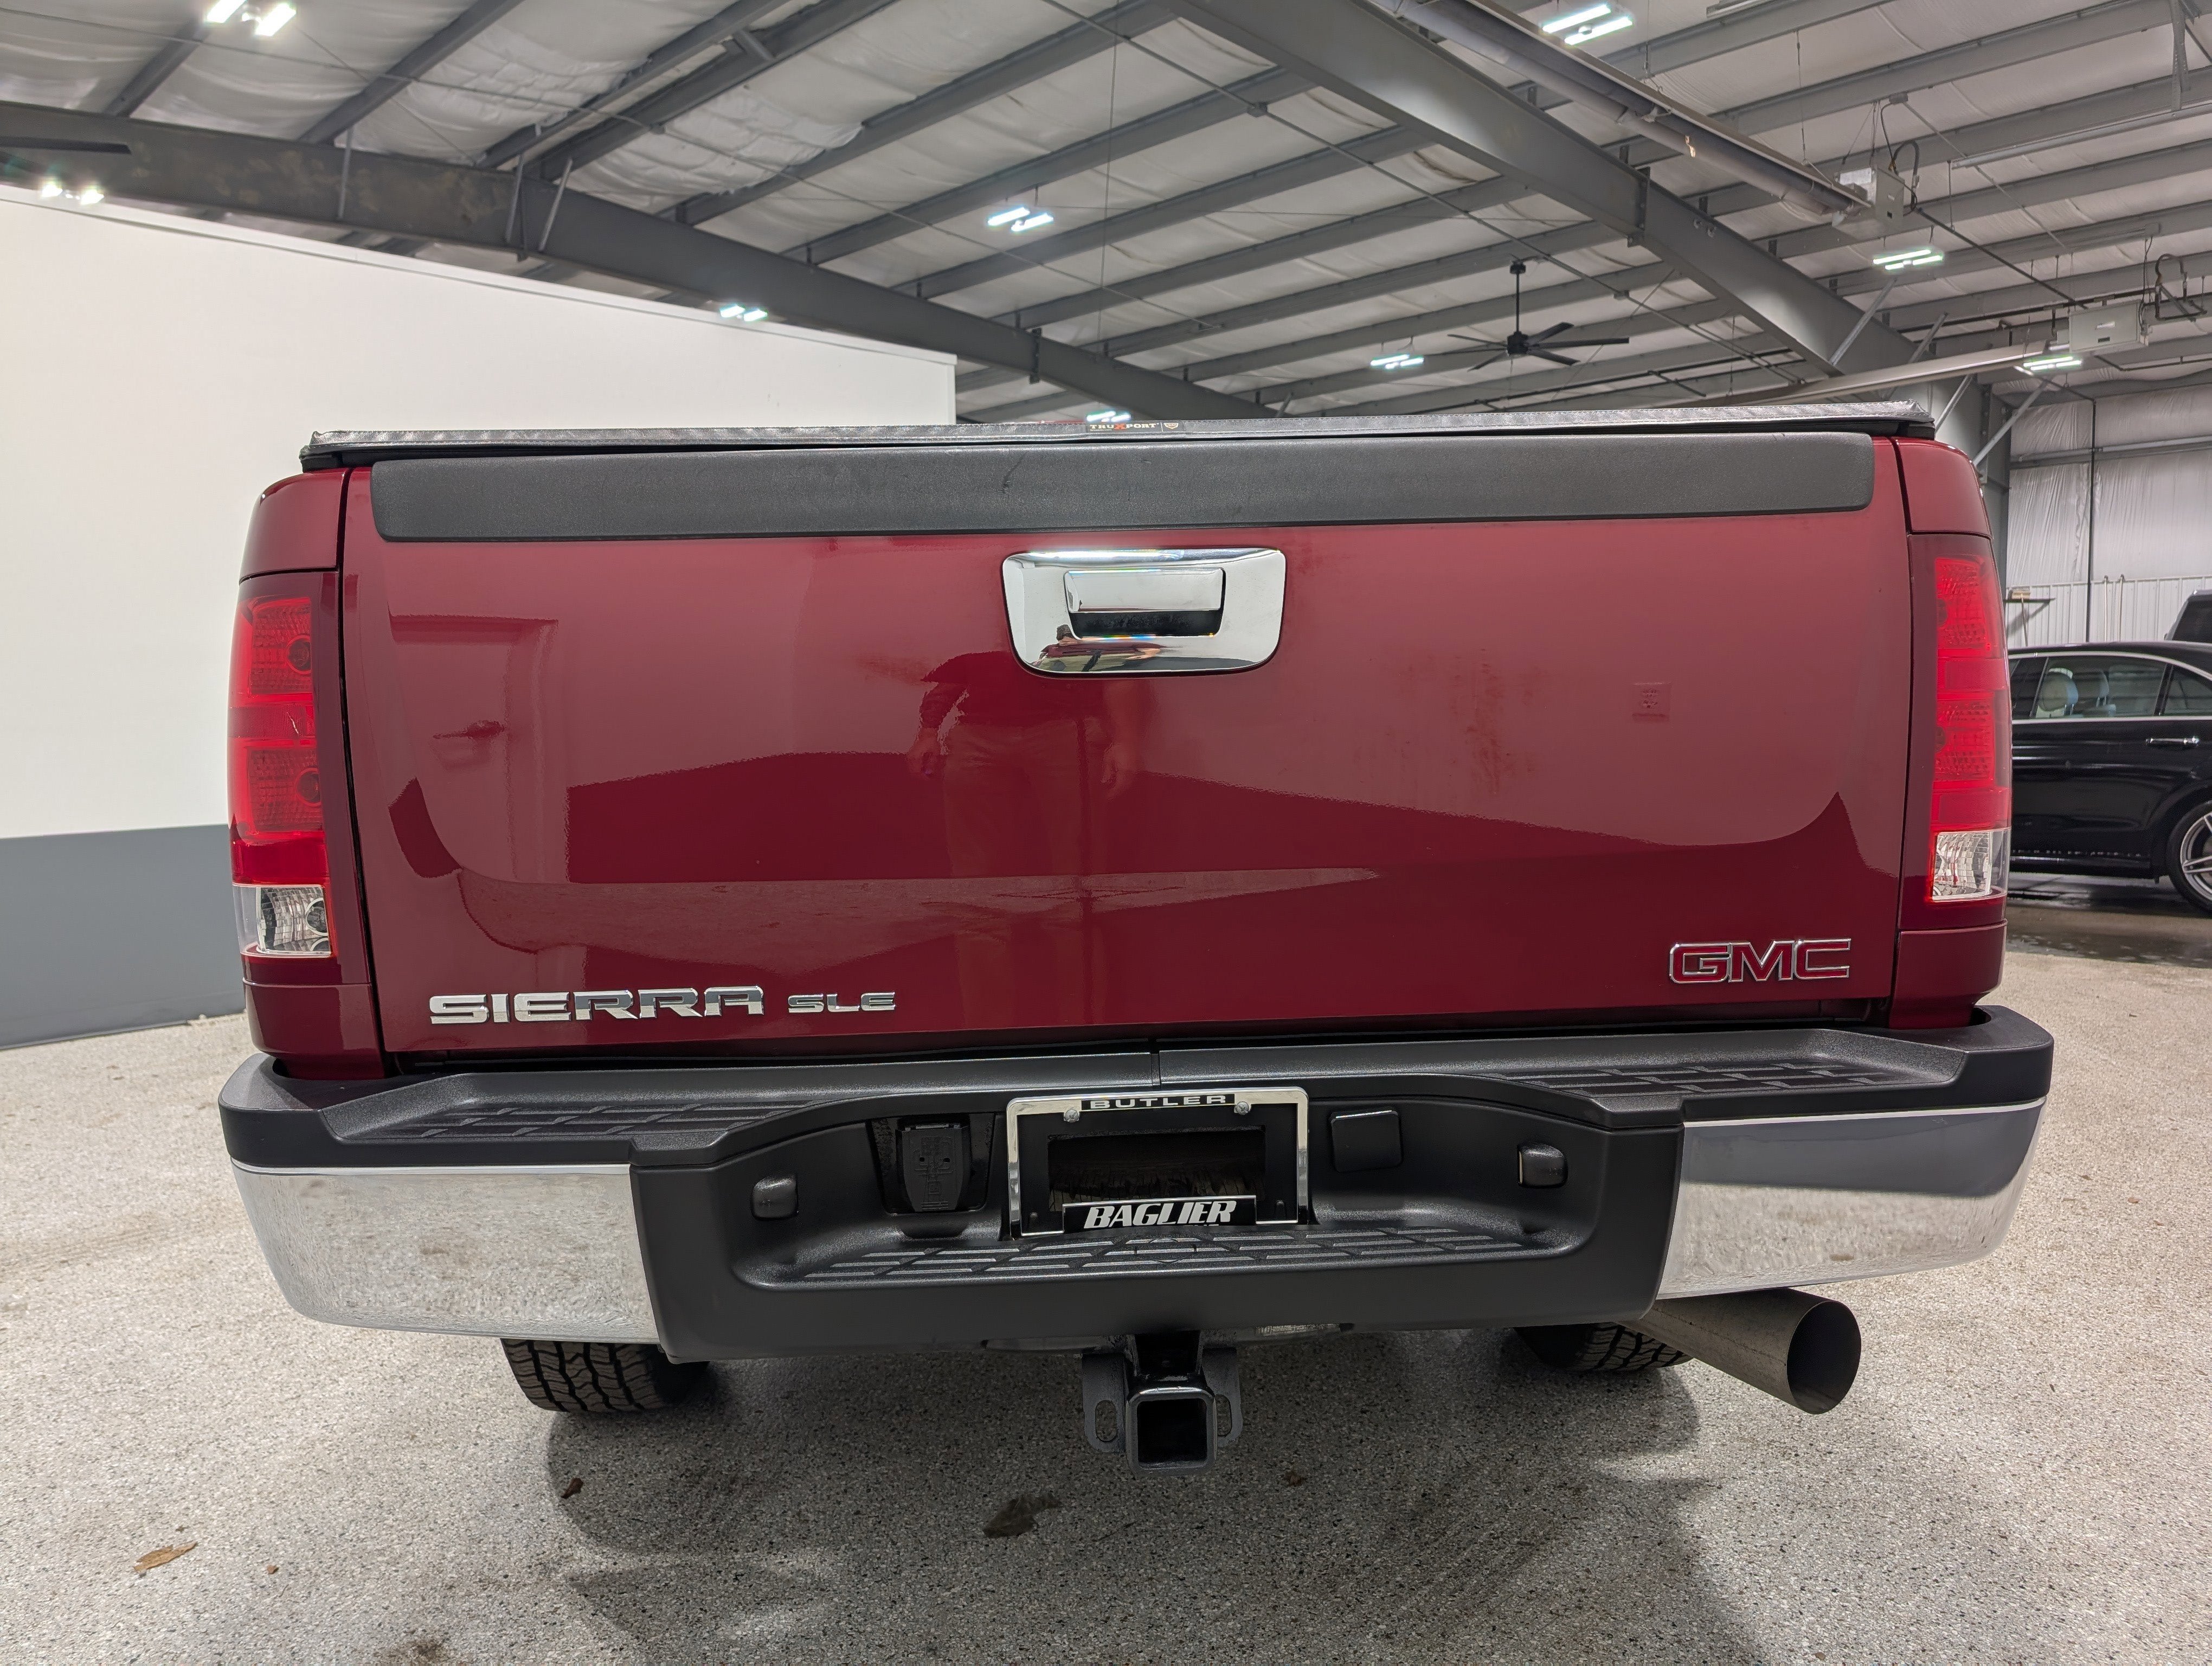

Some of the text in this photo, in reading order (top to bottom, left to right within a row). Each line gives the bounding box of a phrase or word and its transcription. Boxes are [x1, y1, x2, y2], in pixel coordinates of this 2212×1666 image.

[1669, 938, 1851, 984] GMC
[429, 985, 896, 1024] SIERRA SLE
[1090, 1095, 1227, 1109] BUTLER
[1084, 1200, 1237, 1229] BAGLIER
